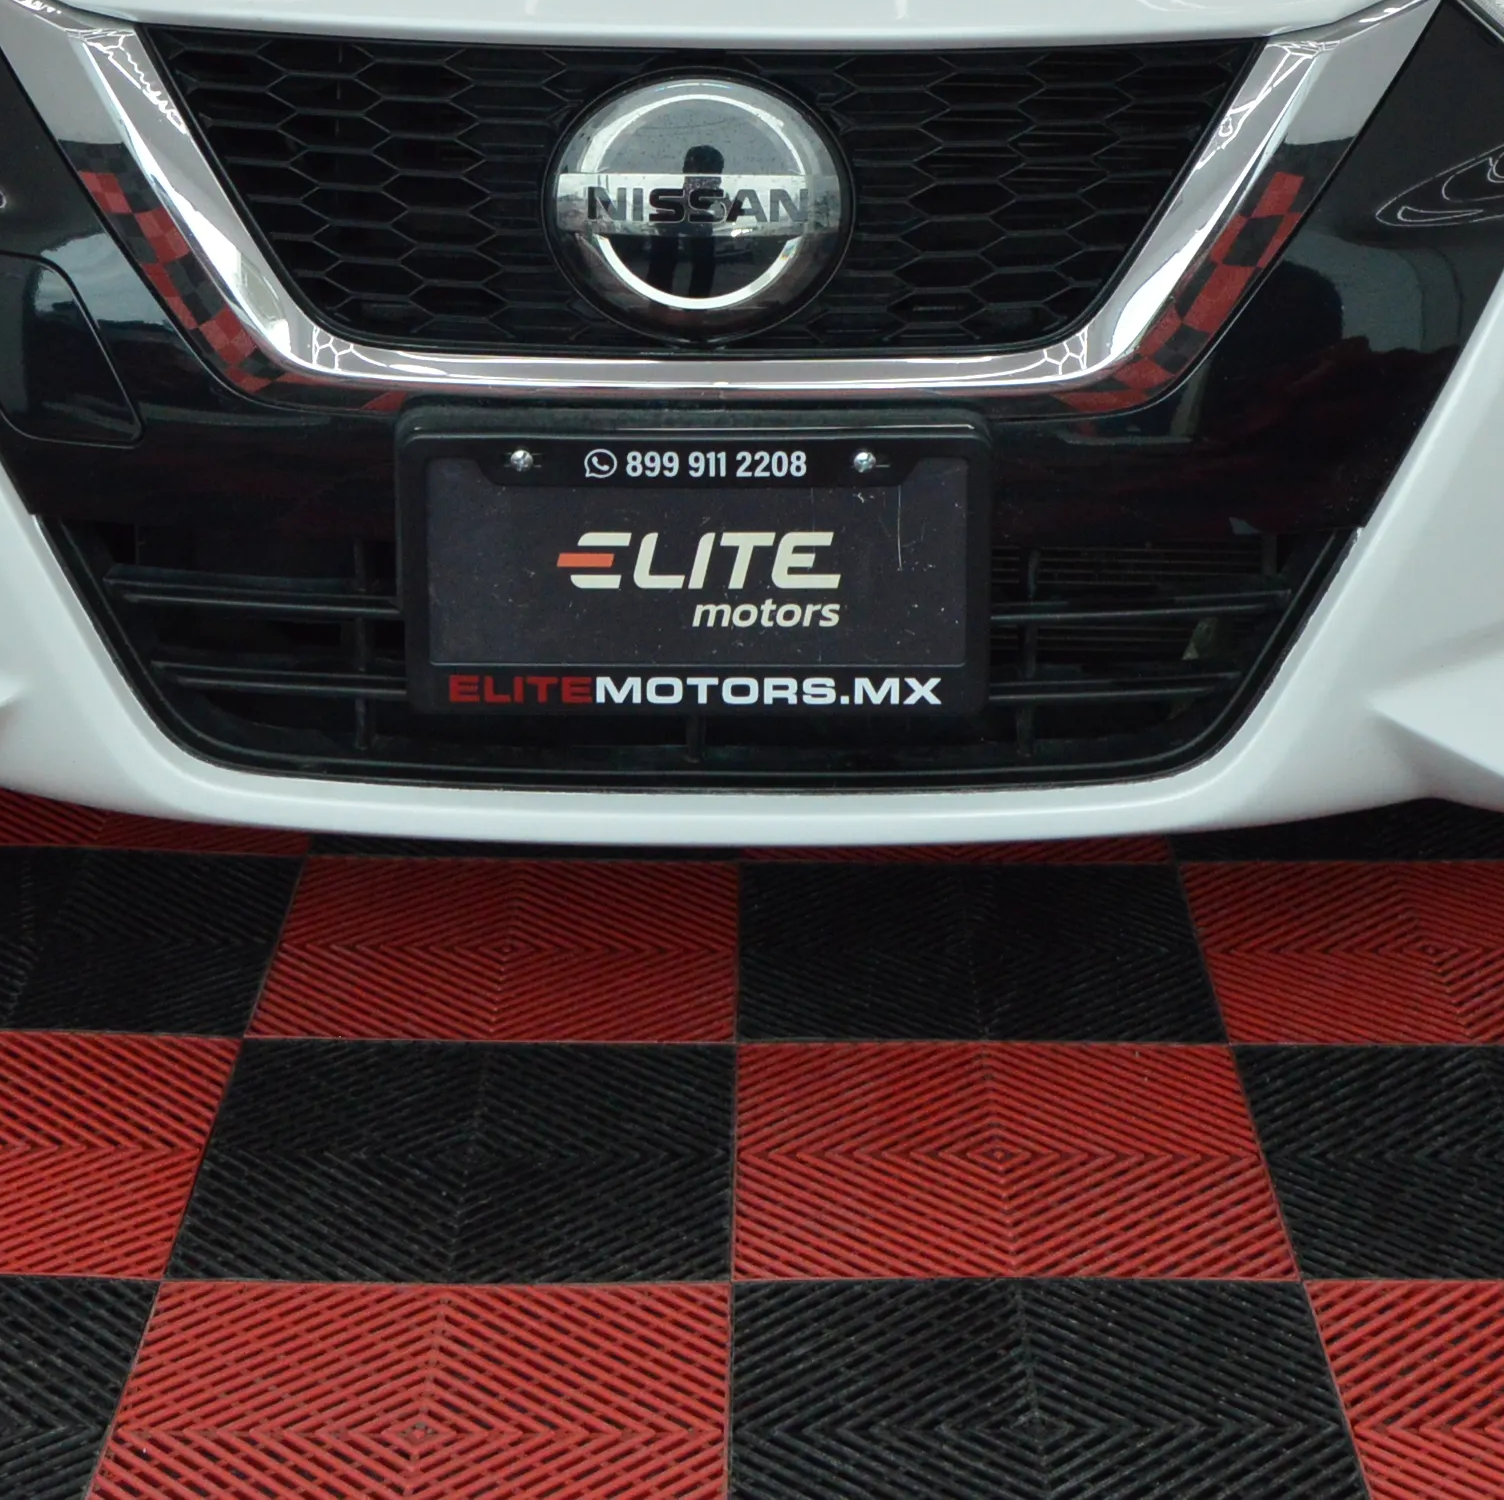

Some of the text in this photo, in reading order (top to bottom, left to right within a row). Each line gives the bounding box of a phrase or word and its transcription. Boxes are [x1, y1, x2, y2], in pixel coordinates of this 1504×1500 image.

[587, 186, 809, 224] NISSAN
[625, 451, 808, 479] 899 911 2208
[556, 531, 842, 590] ELITE
[692, 598, 841, 629] motors
[448, 675, 942, 706] ELITEMOTORS.MX
